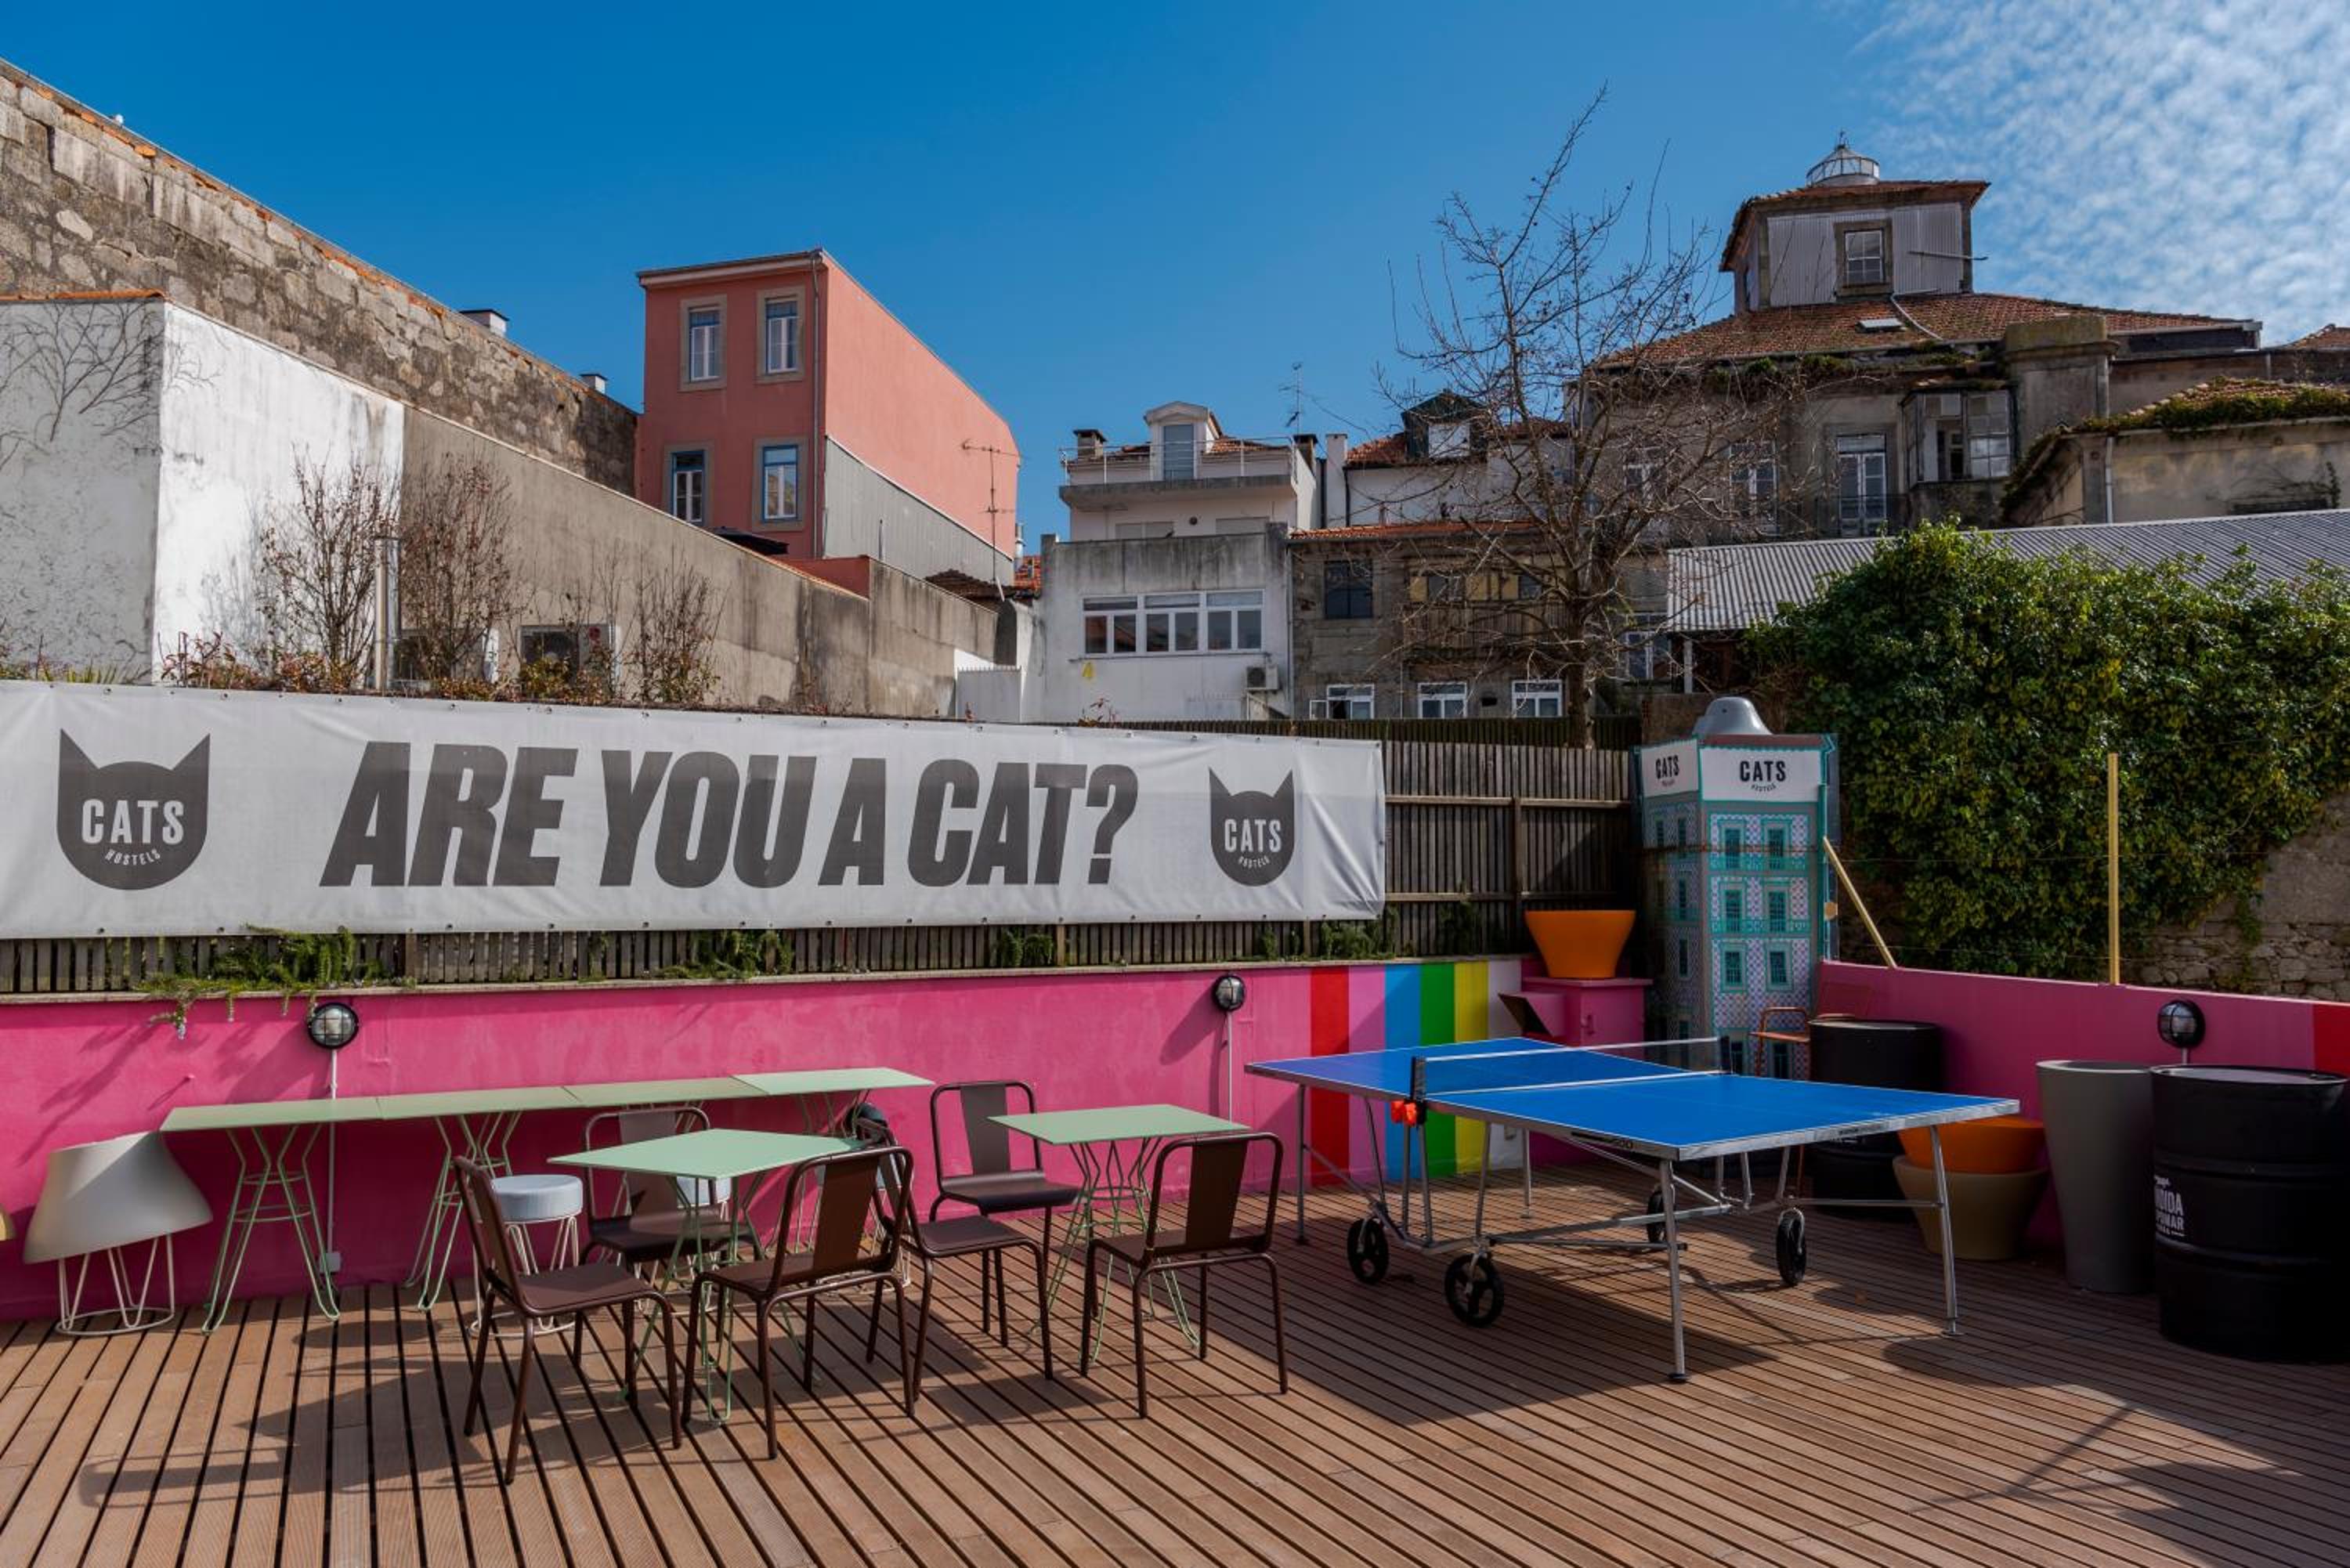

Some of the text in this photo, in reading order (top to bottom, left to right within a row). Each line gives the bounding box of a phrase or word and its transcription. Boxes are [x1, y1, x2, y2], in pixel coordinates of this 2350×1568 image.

[1655, 754, 1679, 779] CATS
[1739, 761, 1787, 782] CATS
[81, 799, 184, 844] CATS
[319, 741, 1138, 888] ARE YOU A CAT?
[1224, 818, 1281, 852] CATS
